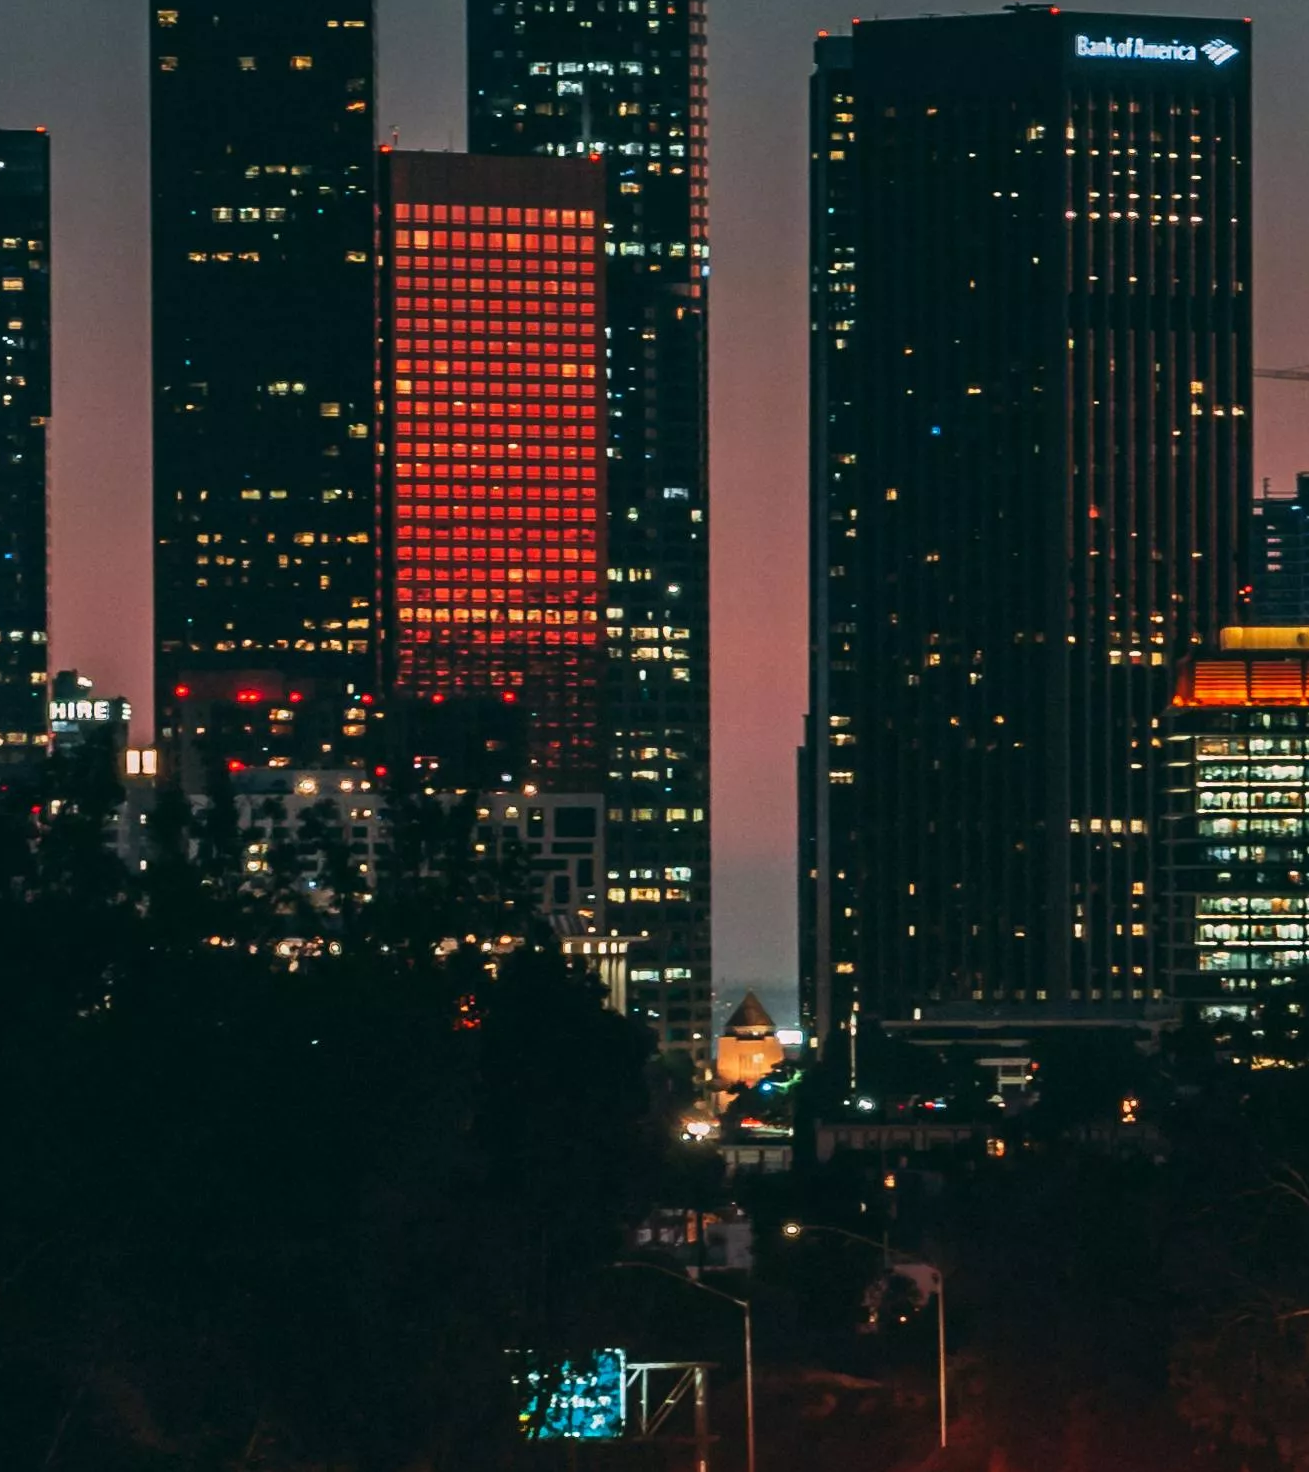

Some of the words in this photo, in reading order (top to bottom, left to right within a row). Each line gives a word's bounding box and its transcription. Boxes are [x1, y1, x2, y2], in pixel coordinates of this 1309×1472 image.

[1078, 36, 1116, 56] Bank
[1117, 38, 1133, 57] of
[1134, 38, 1196, 60] America
